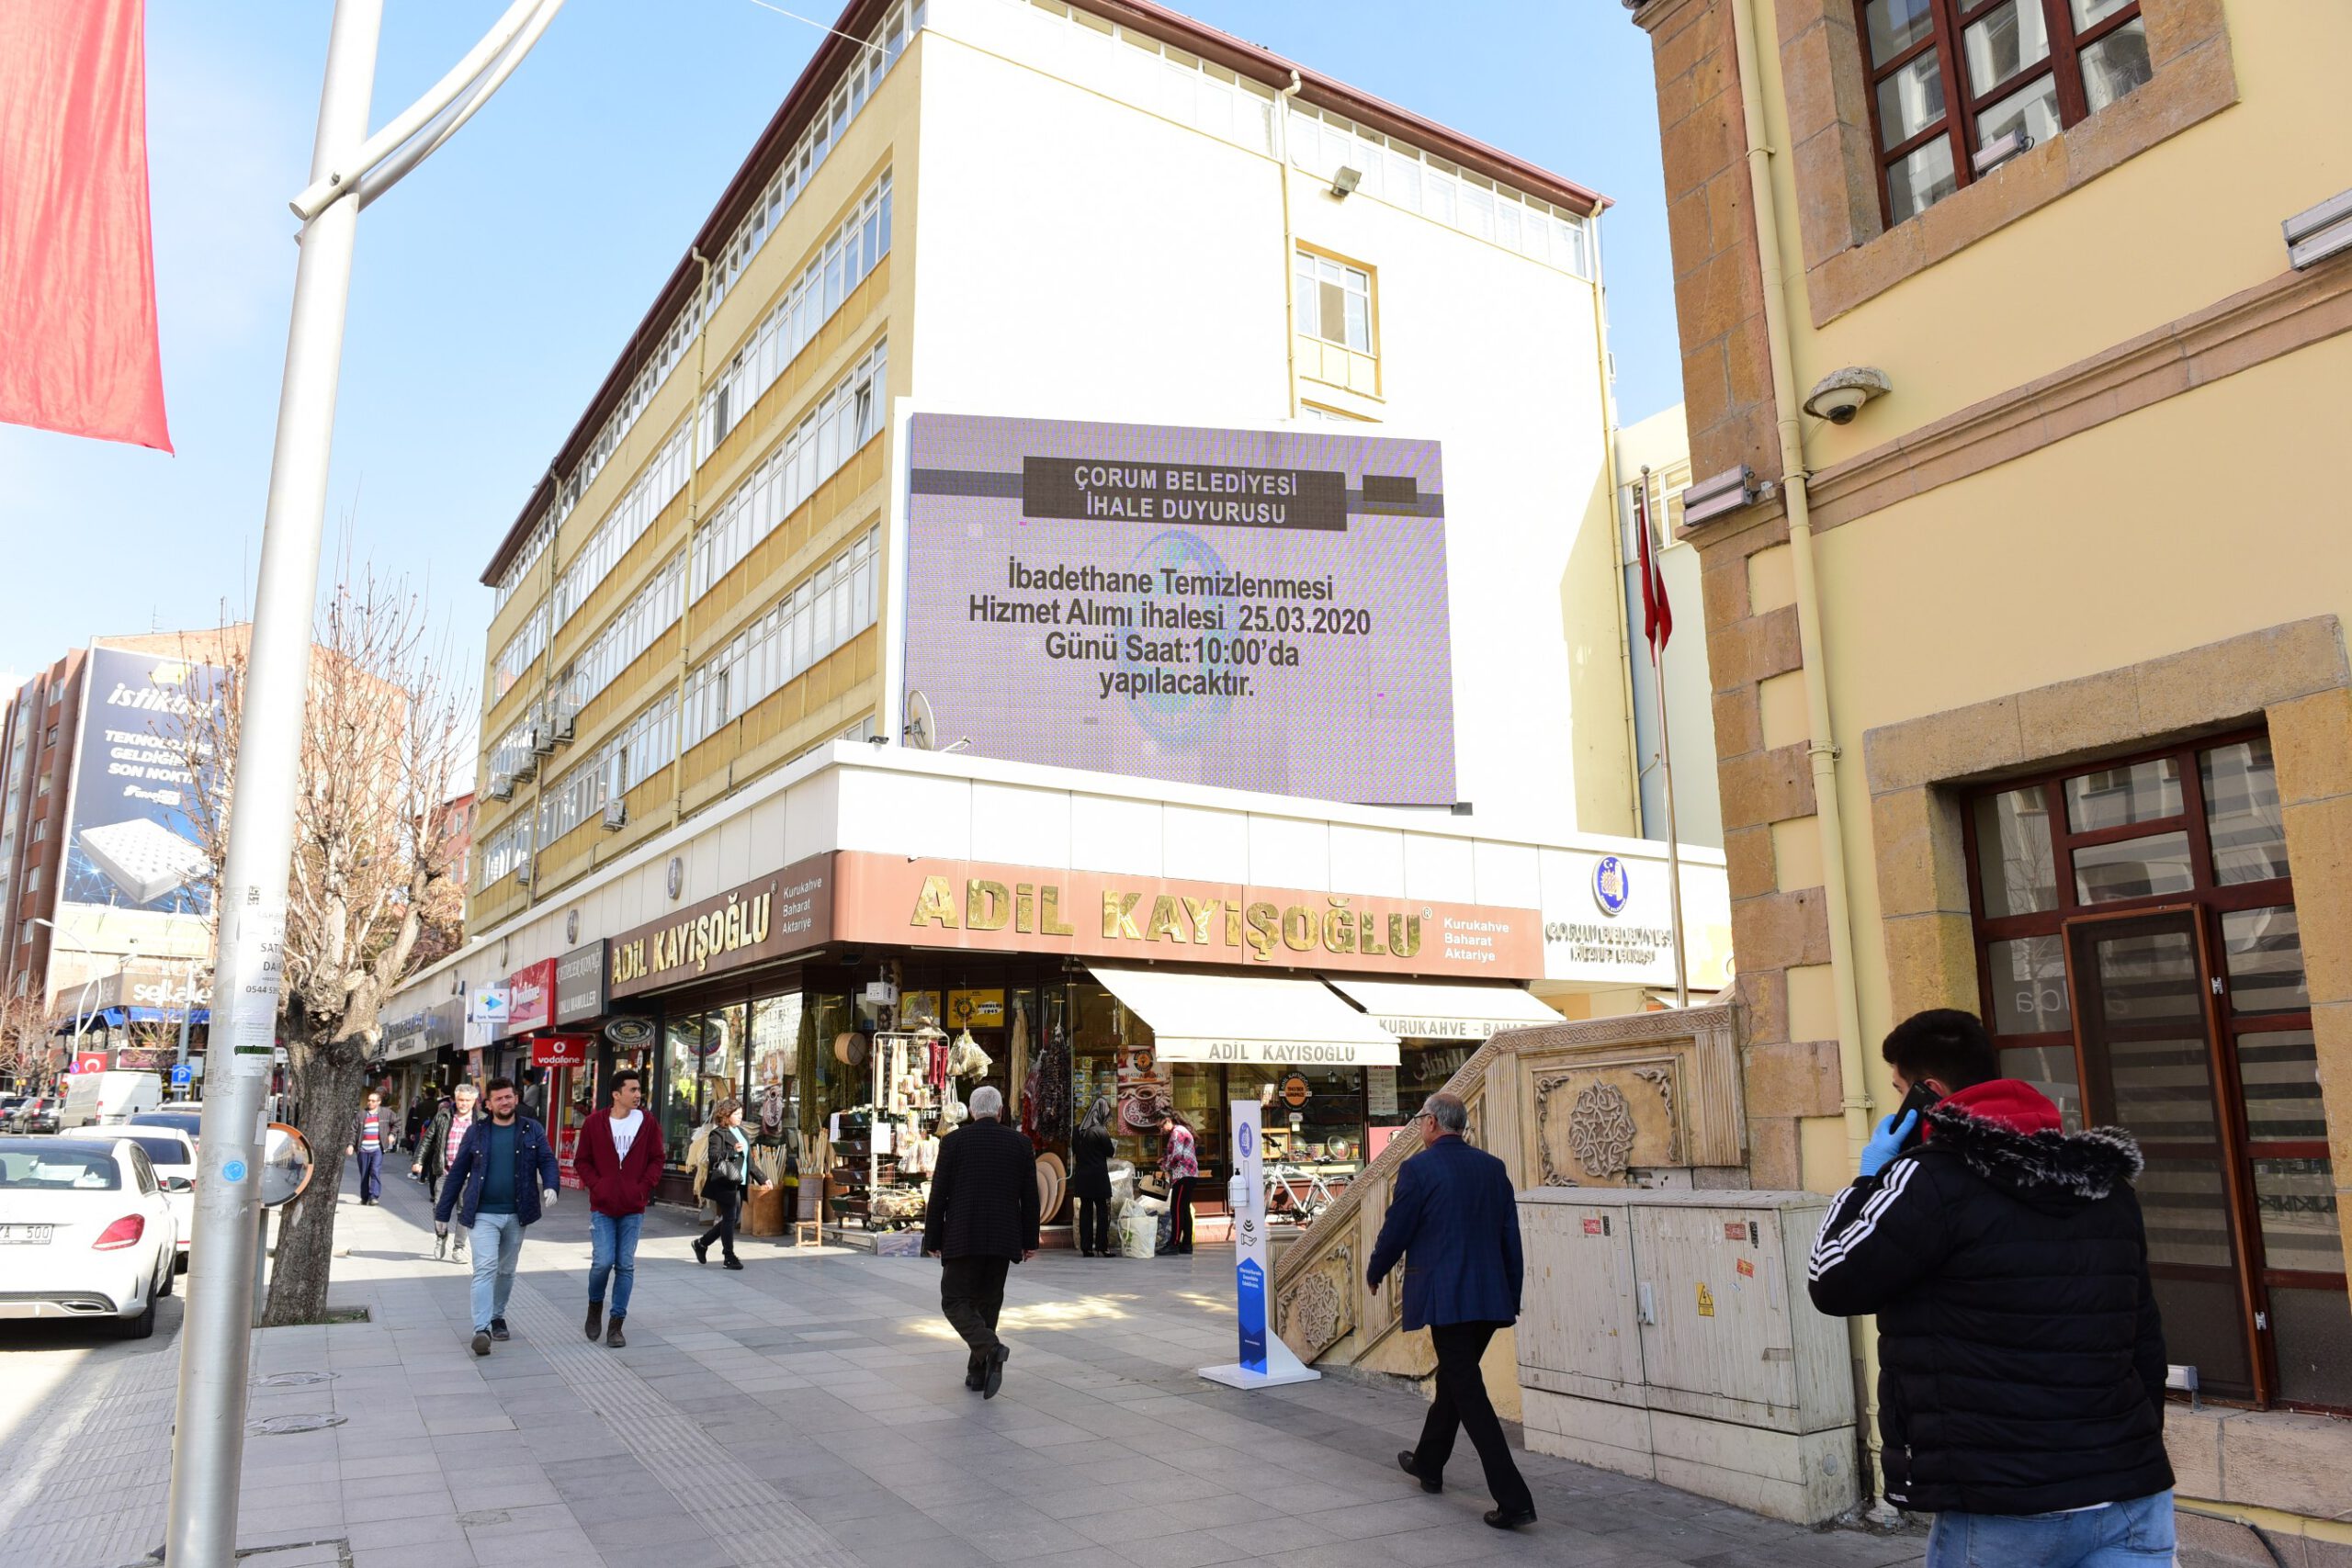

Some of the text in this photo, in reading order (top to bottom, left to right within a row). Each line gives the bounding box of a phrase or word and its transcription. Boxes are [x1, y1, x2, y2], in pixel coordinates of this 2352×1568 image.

[1075, 466, 1296, 496] ÇORUM BELEDİYESİ
[1087, 491, 1286, 524] İHALE DUYURUSU
[1009, 555, 1333, 600] İbadethane Temizlenmesi
[969, 594, 1371, 635] Hizmet Alımı ihalesi 25.03.2020
[1046, 631, 1117, 660] Günü
[1099, 666, 1254, 700] yapılacaktır.
[107, 762, 145, 778] SON
[783, 876, 822, 899] Kurukahve
[783, 898, 811, 918] Baharat
[782, 917, 812, 935] Aktariye
[1443, 917, 1510, 933] Kurukahve
[1444, 931, 1493, 947] Baharat
[1444, 947, 1496, 964] Aktariye
[538, 1055, 581, 1065] vodafone
[1208, 1042, 1250, 1060] ADİL
[27, 1225, 50, 1239] 500
